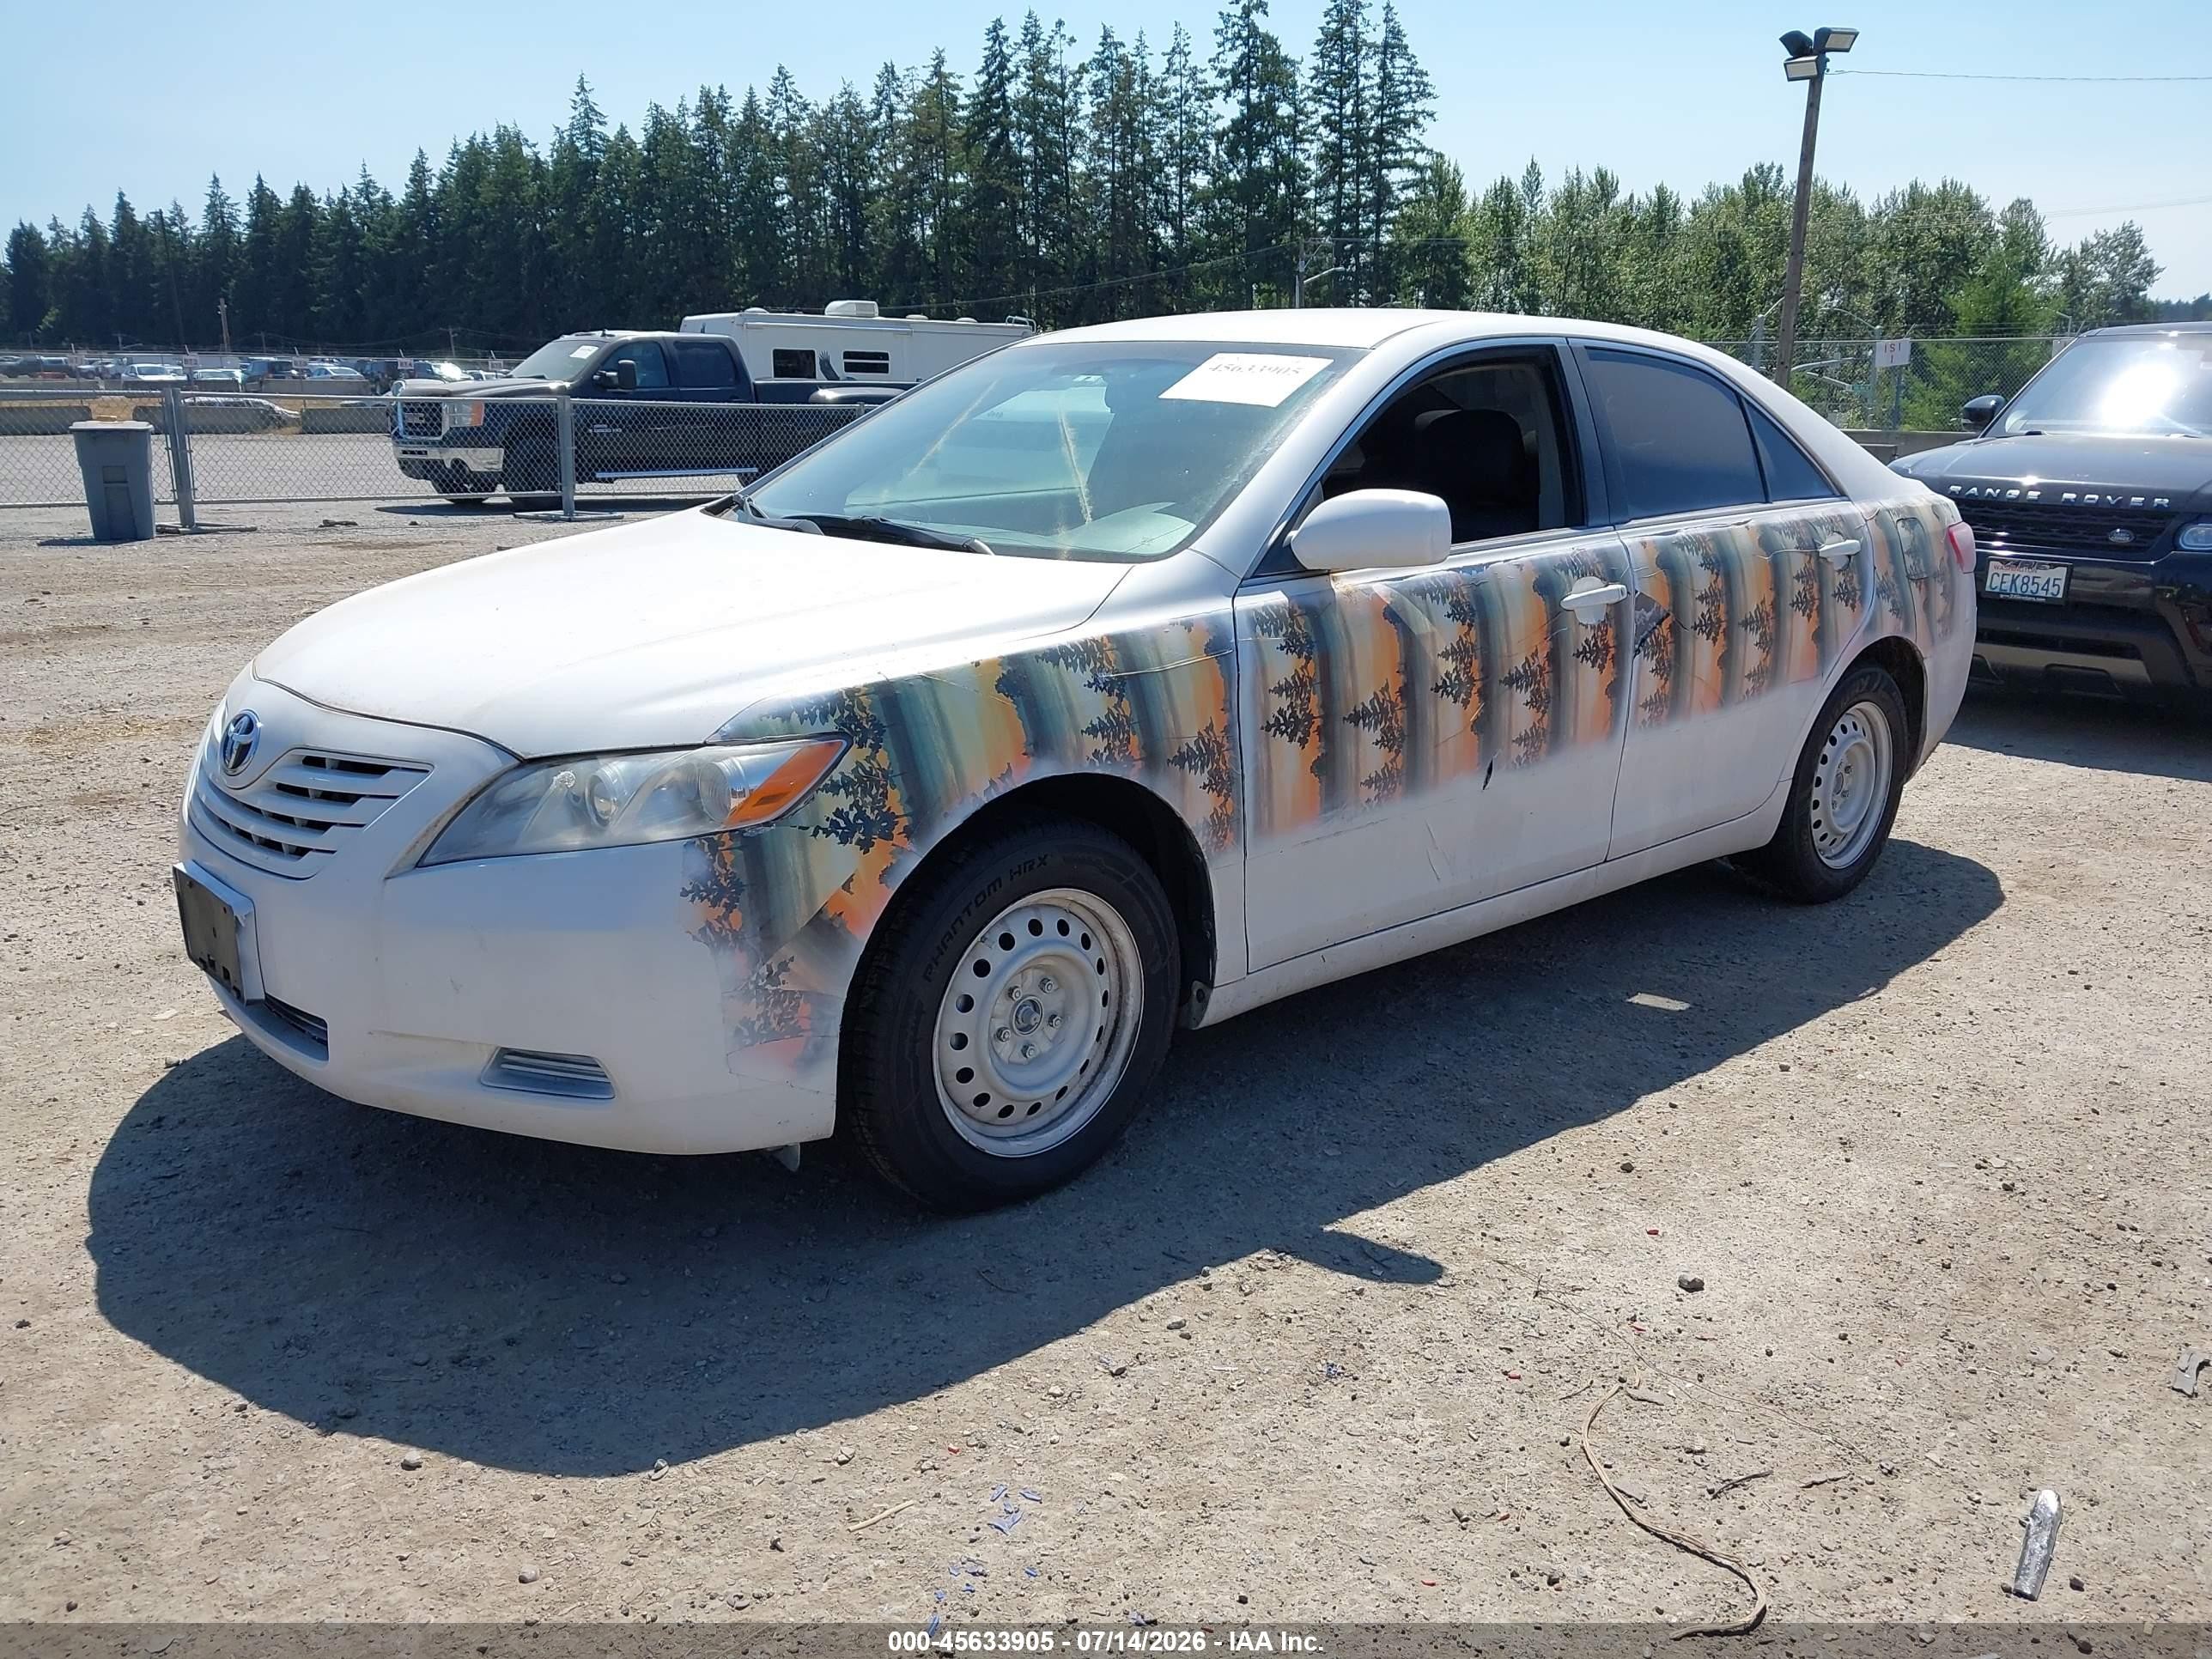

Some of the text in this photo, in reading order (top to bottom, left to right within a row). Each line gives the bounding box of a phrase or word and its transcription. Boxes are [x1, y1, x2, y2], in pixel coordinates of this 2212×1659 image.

[1947, 484, 2171, 507] RANGE ROVER
[1989, 572, 2063, 597] CEK8545
[922, 876, 1003, 983] PHANTOM
